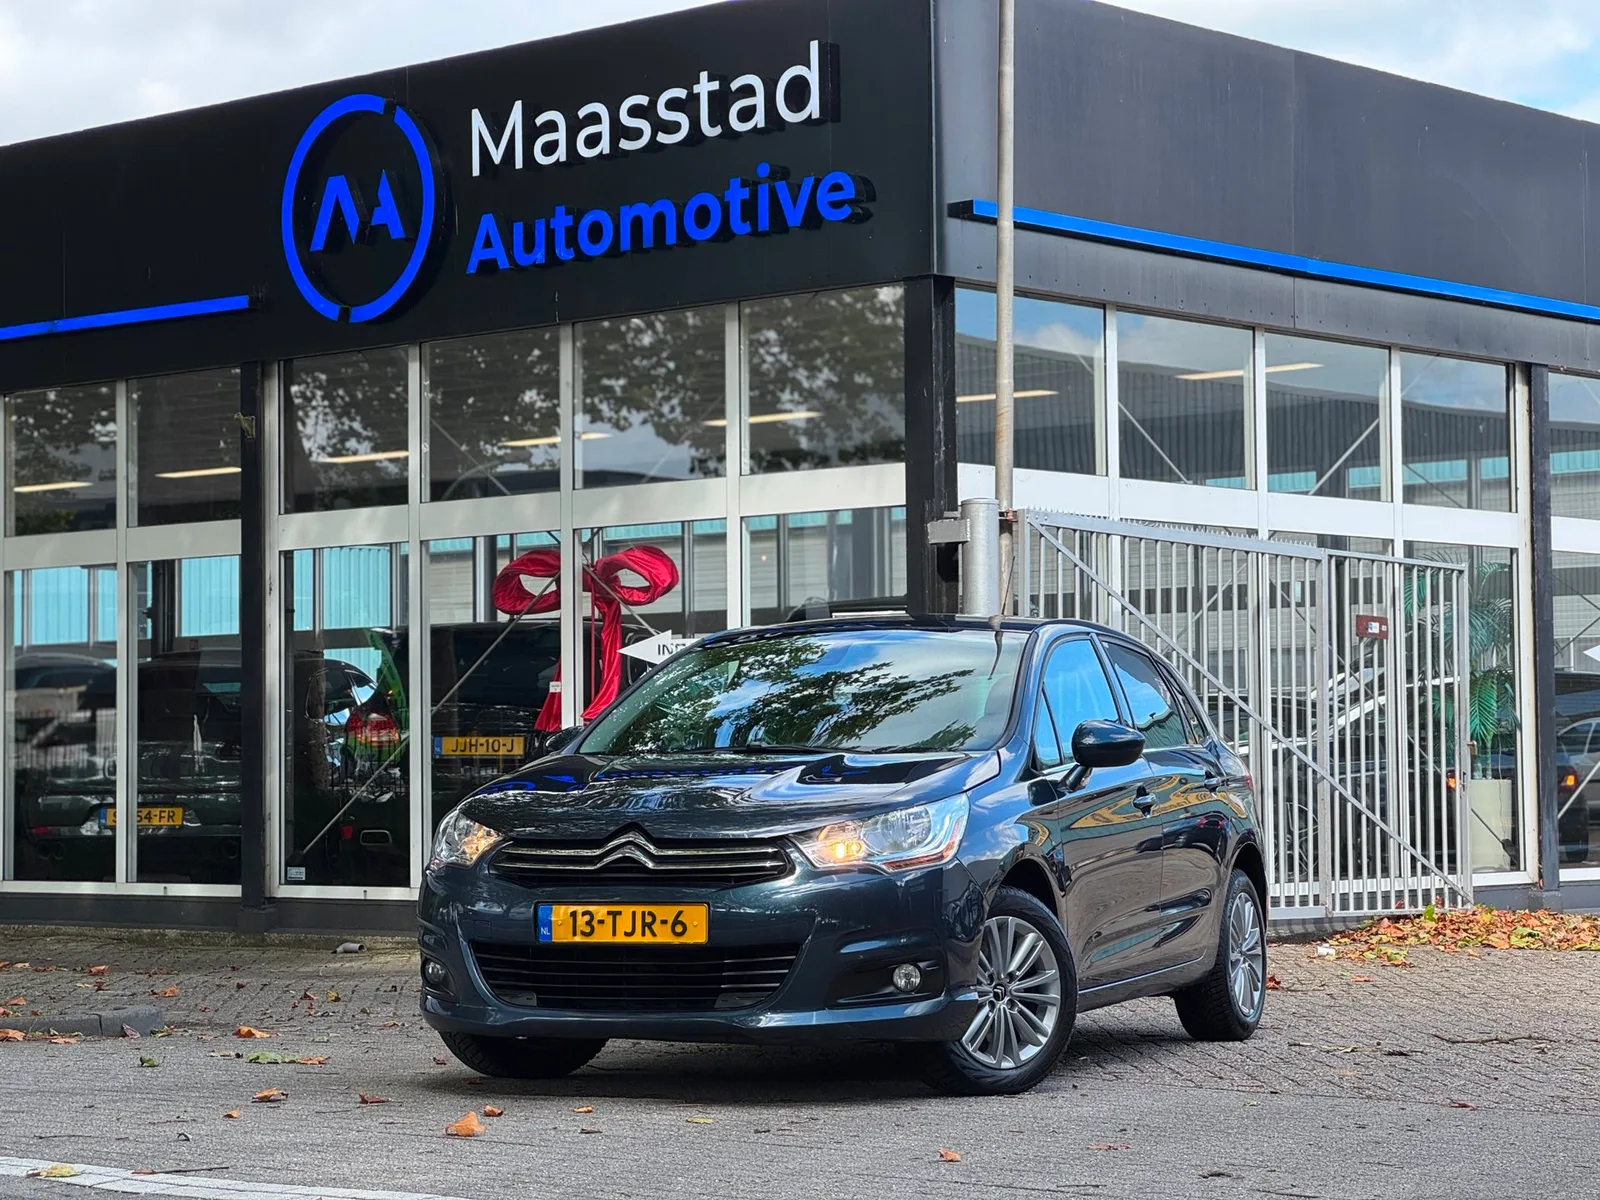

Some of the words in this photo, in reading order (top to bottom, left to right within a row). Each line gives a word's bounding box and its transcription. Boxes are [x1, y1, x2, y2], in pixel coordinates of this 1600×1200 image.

[470, 39, 822, 177] Maasstad
[466, 161, 857, 275] Automotive
[451, 738, 514, 752] JJH-10-J
[540, 926, 550, 935] NL
[569, 910, 688, 937] 13-TJR-6
